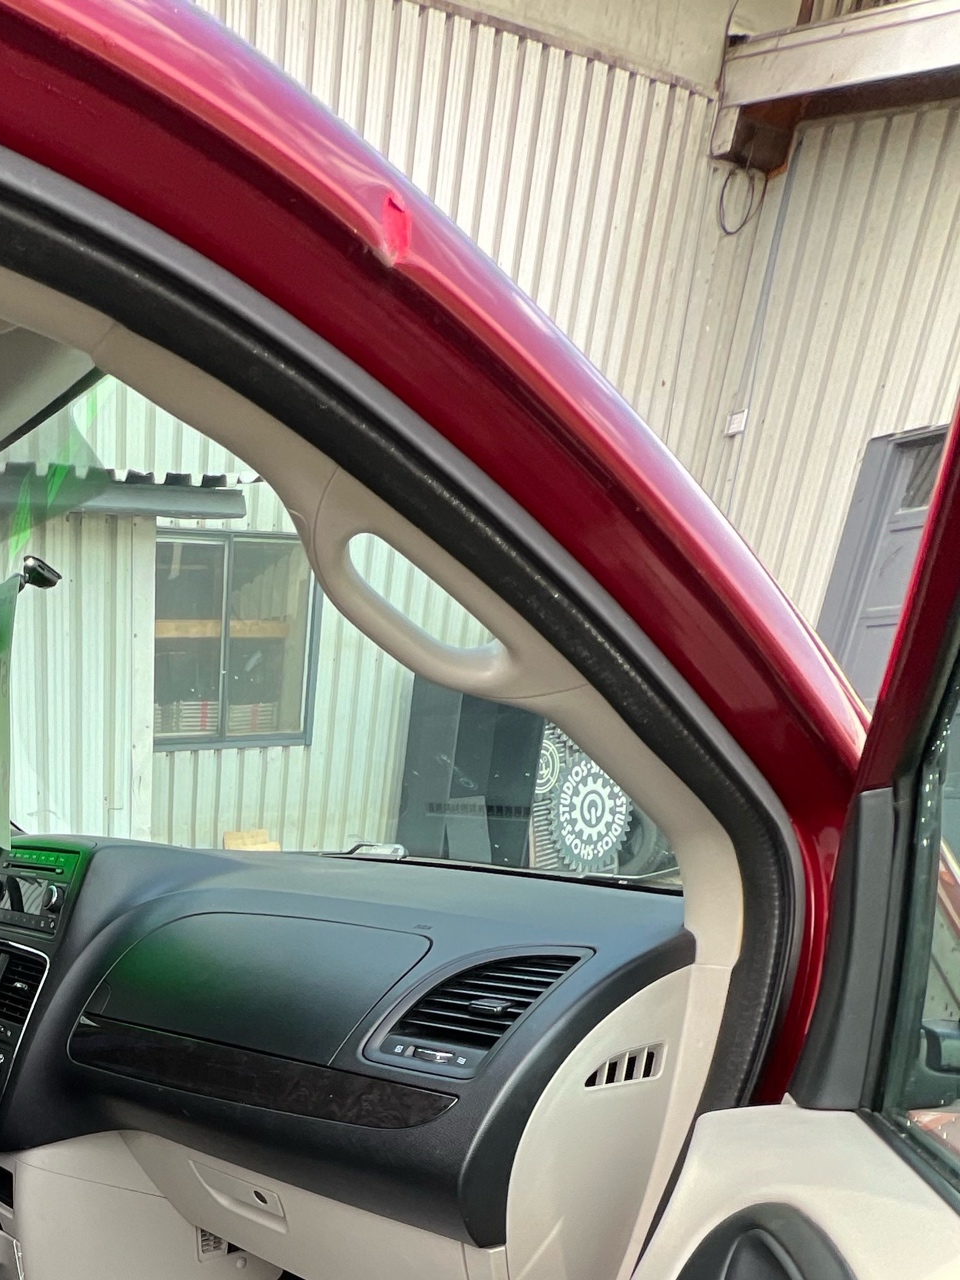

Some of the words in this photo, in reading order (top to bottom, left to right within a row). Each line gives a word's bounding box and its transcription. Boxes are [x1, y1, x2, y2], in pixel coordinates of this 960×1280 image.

[559, 760, 587, 822] STUDIOS
[561, 825, 594, 861] SHOPS
[597, 796, 627, 857] STUDIOS
